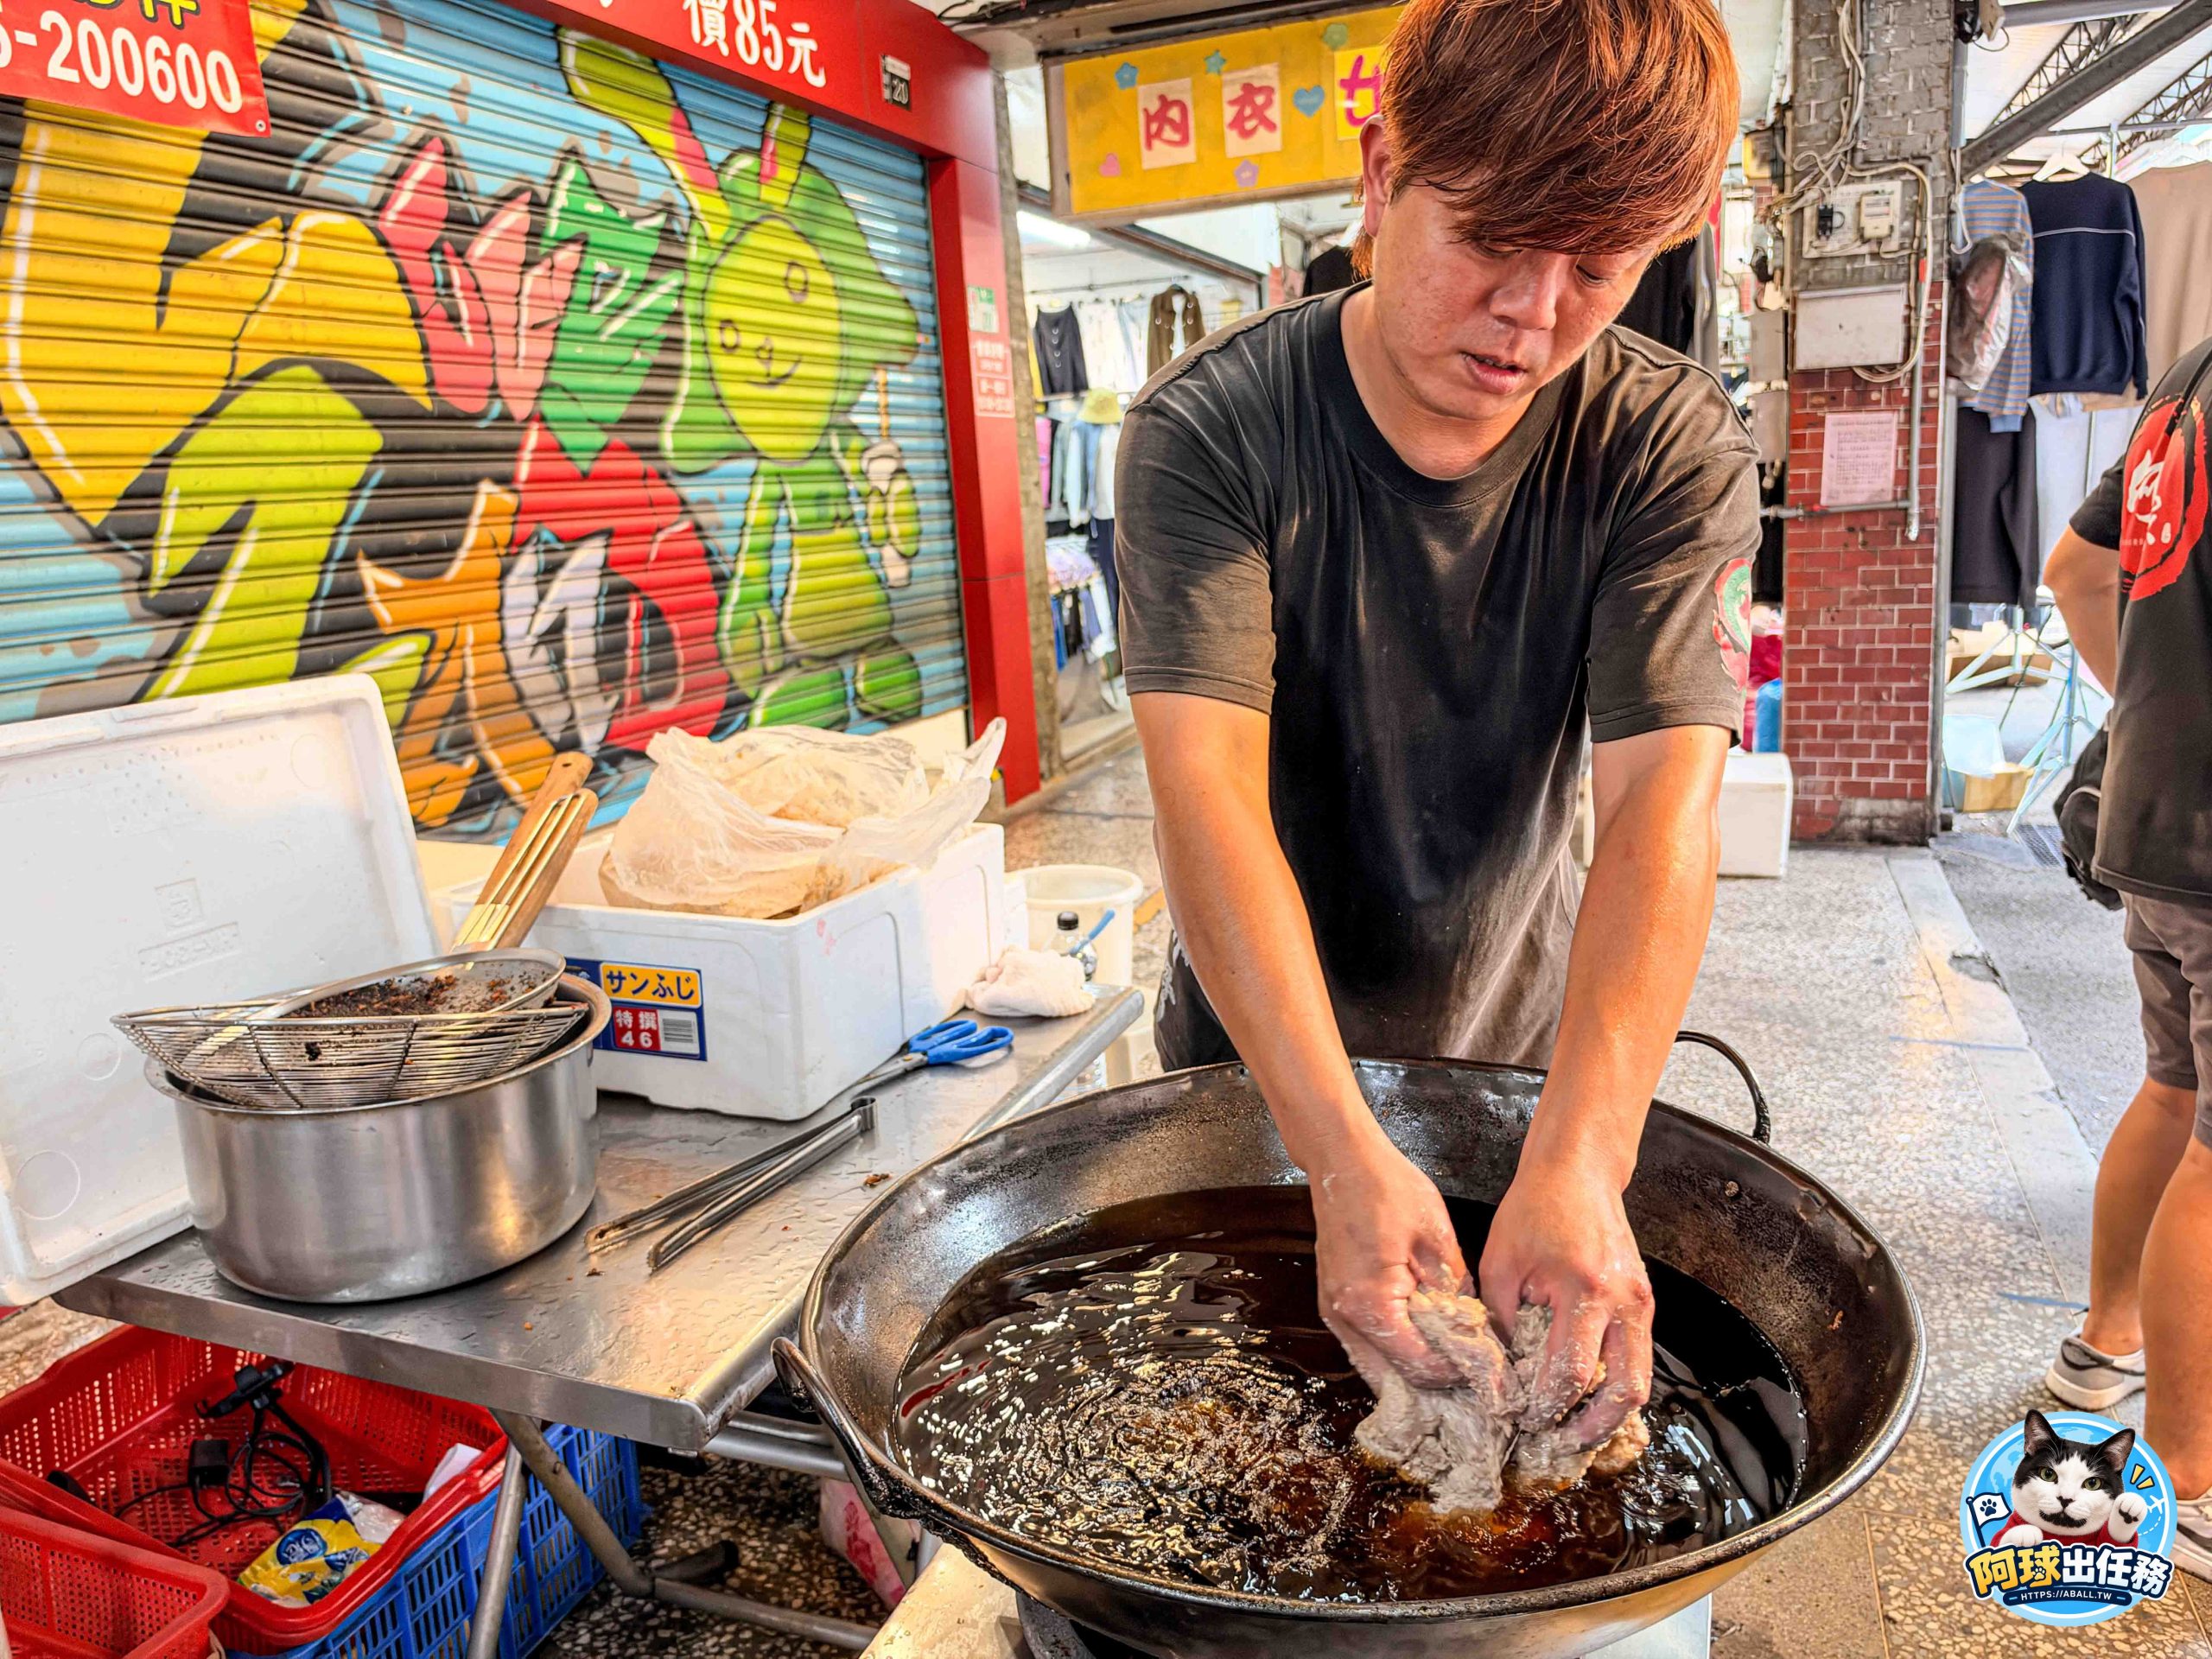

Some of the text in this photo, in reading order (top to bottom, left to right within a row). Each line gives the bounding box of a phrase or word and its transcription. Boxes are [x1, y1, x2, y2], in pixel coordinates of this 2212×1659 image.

[607, 970, 694, 1000] サンふじ
[615, 1010, 657, 1030] 特撰
